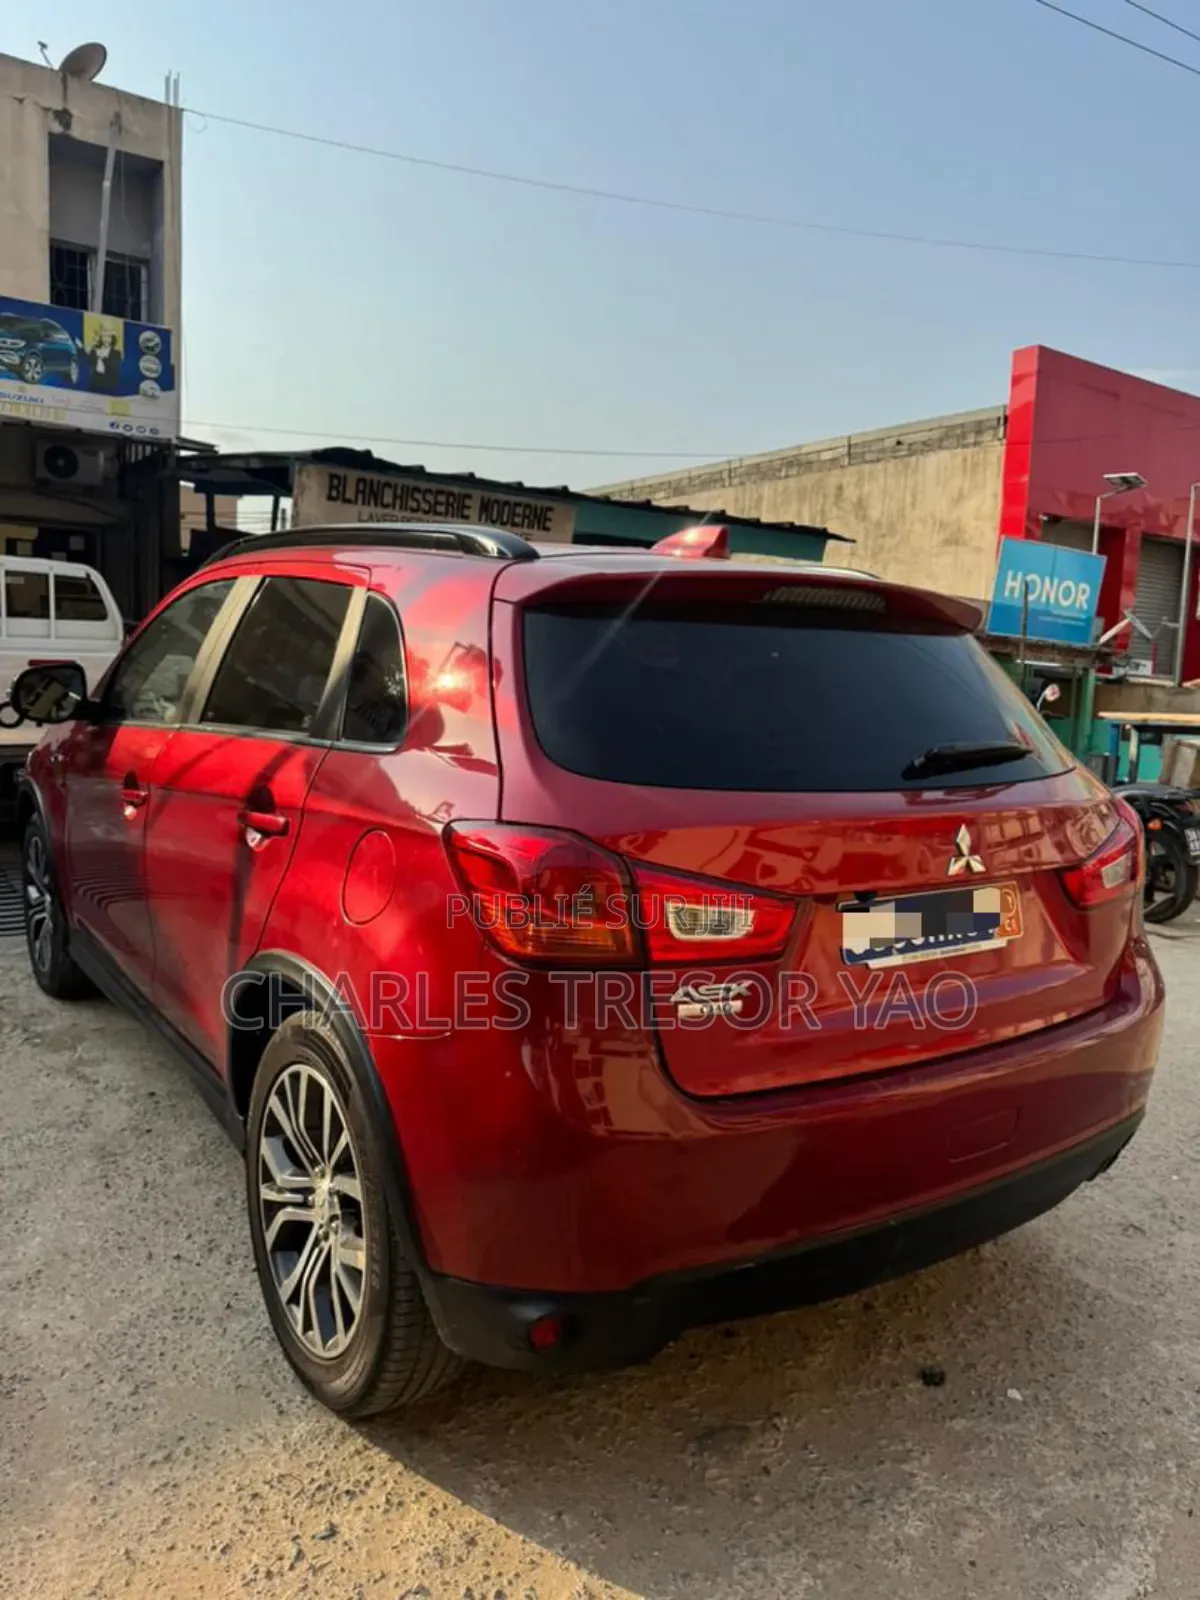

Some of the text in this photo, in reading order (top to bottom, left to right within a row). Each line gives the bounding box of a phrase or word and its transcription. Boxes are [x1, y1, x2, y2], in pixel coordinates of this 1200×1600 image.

[326, 472, 555, 532] BLANCHISSERIE MODERNE
[1004, 570, 1091, 610] HONOR
[670, 980, 753, 1002] ASX
